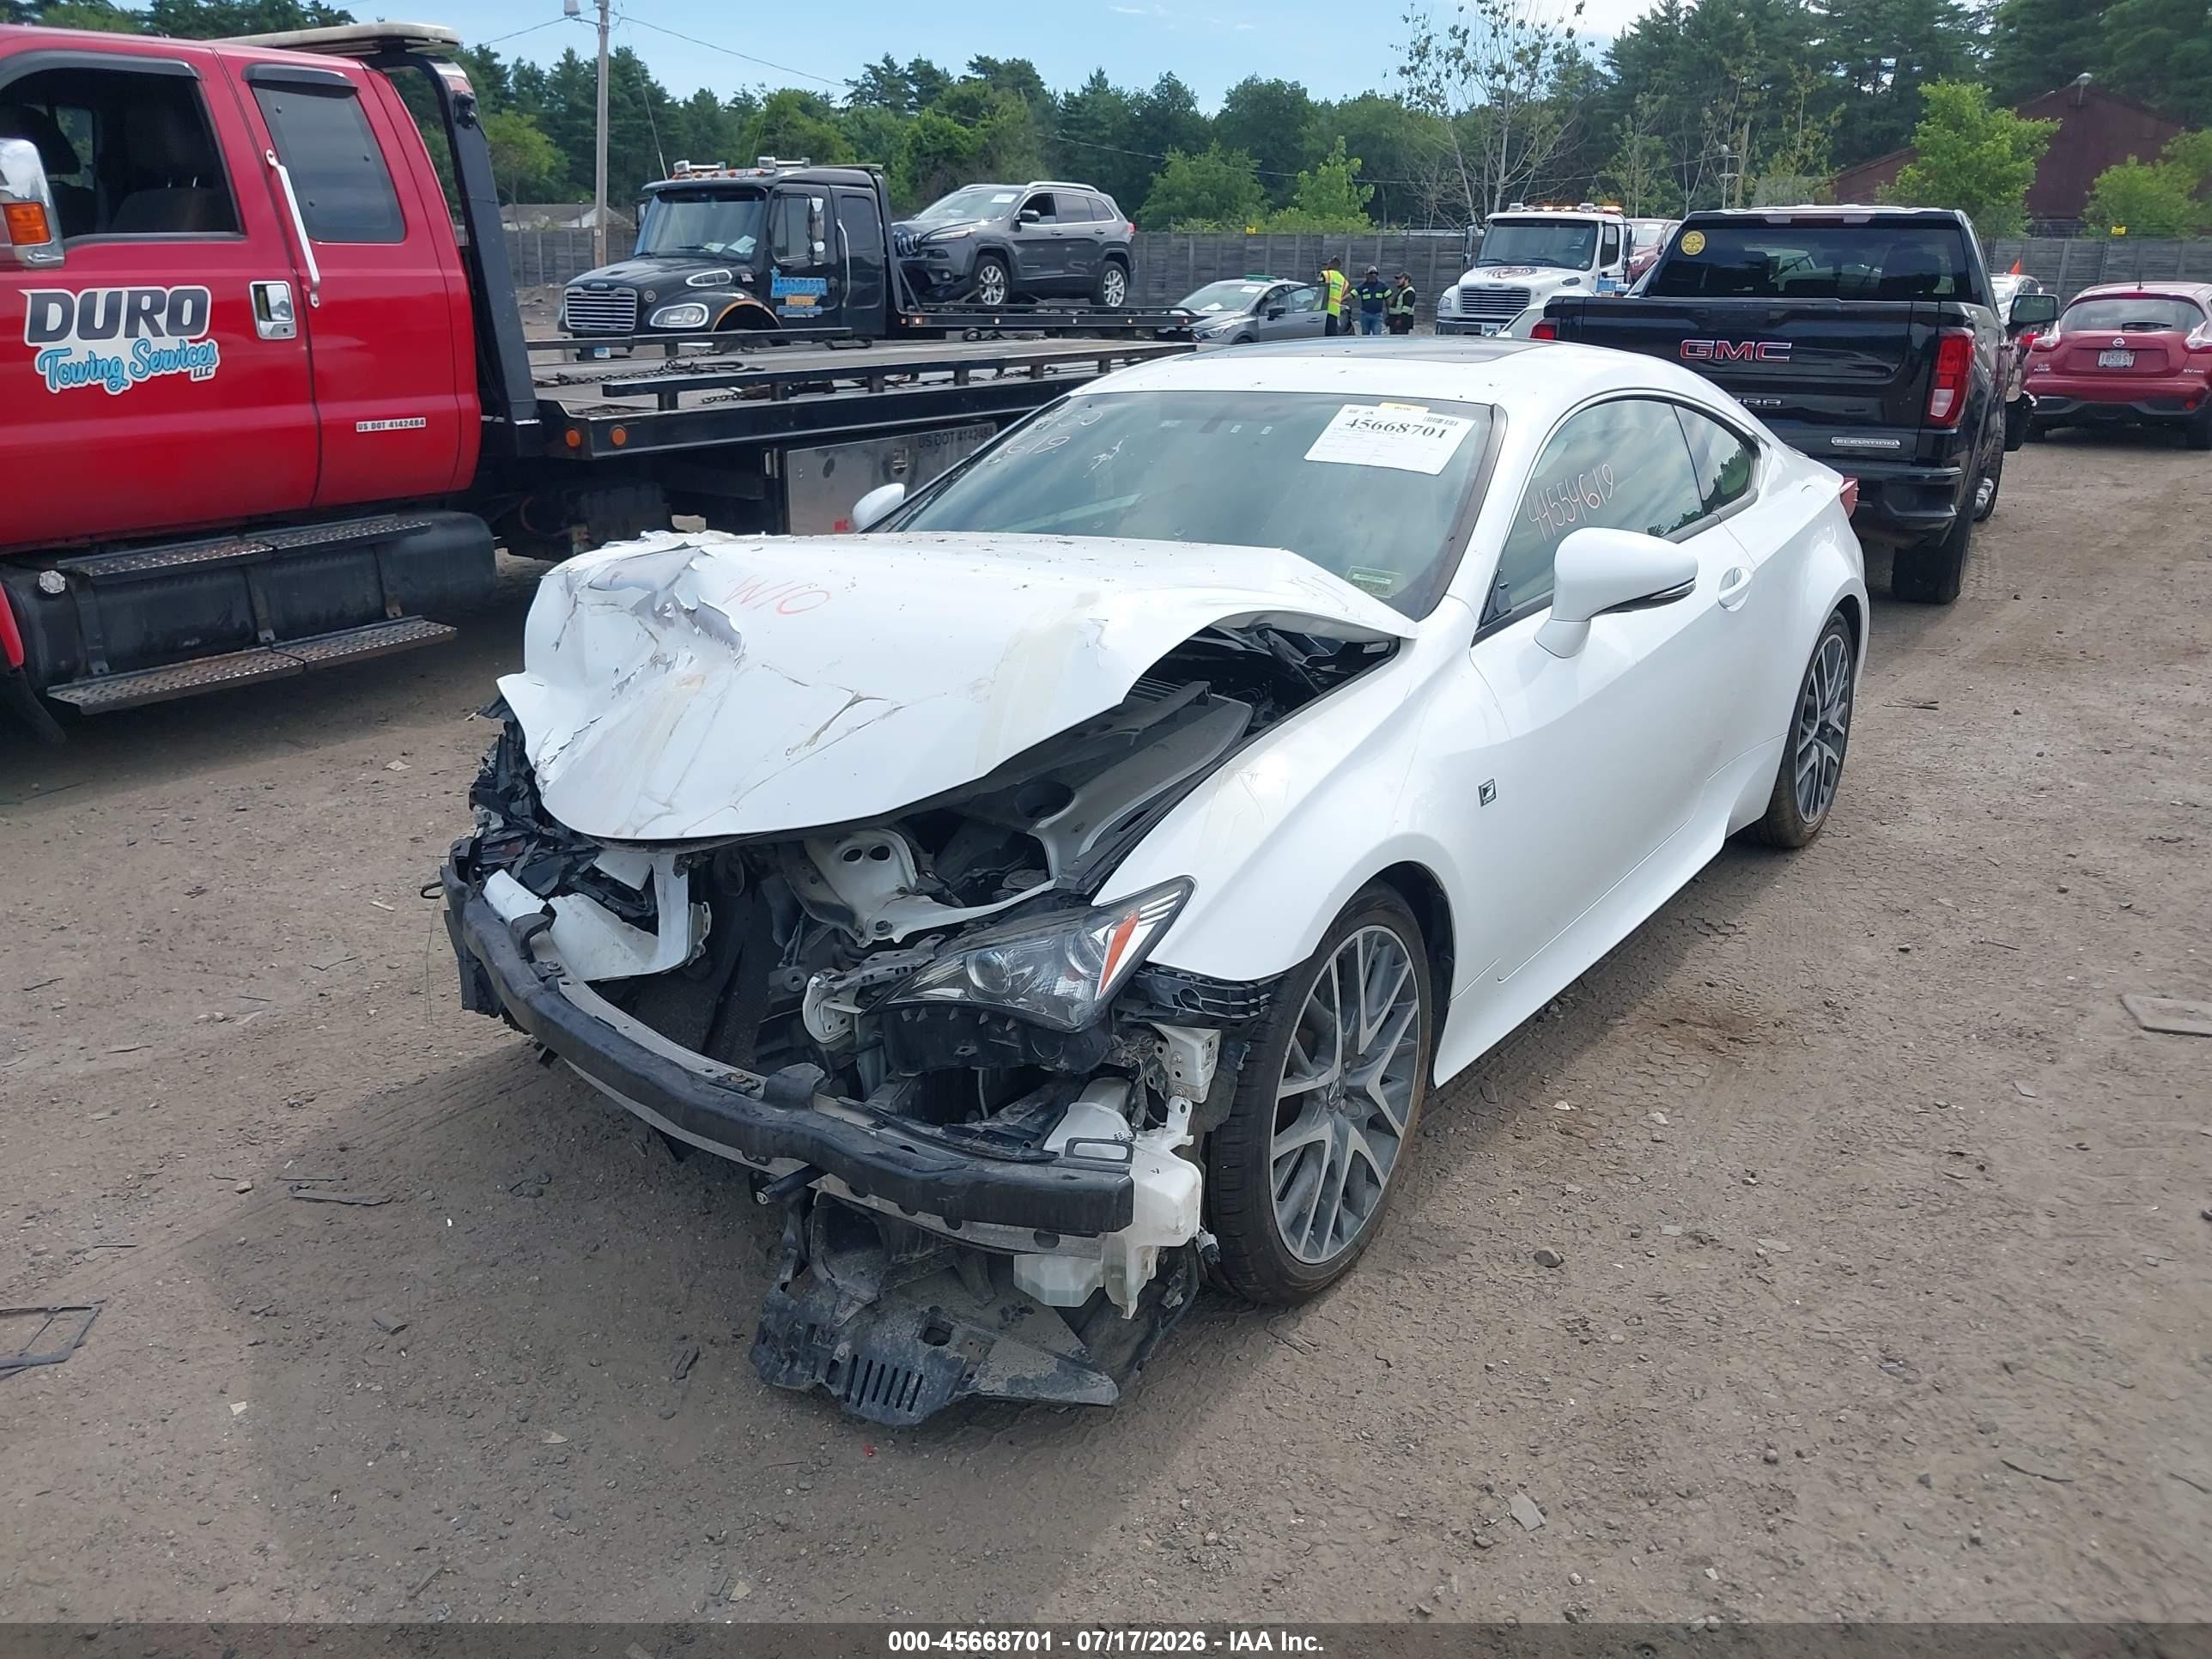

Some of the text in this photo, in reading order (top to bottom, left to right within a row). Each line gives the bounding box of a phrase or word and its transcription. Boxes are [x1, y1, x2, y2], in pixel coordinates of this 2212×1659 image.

[27, 288, 209, 343] DURO
[1680, 339, 1792, 362] GMC
[38, 337, 218, 392] Towing Services
[193, 366, 213, 379] LLC
[1345, 417, 1448, 439] 45668701
[919, 436, 933, 447] US
[1525, 464, 1614, 543] 44554619
